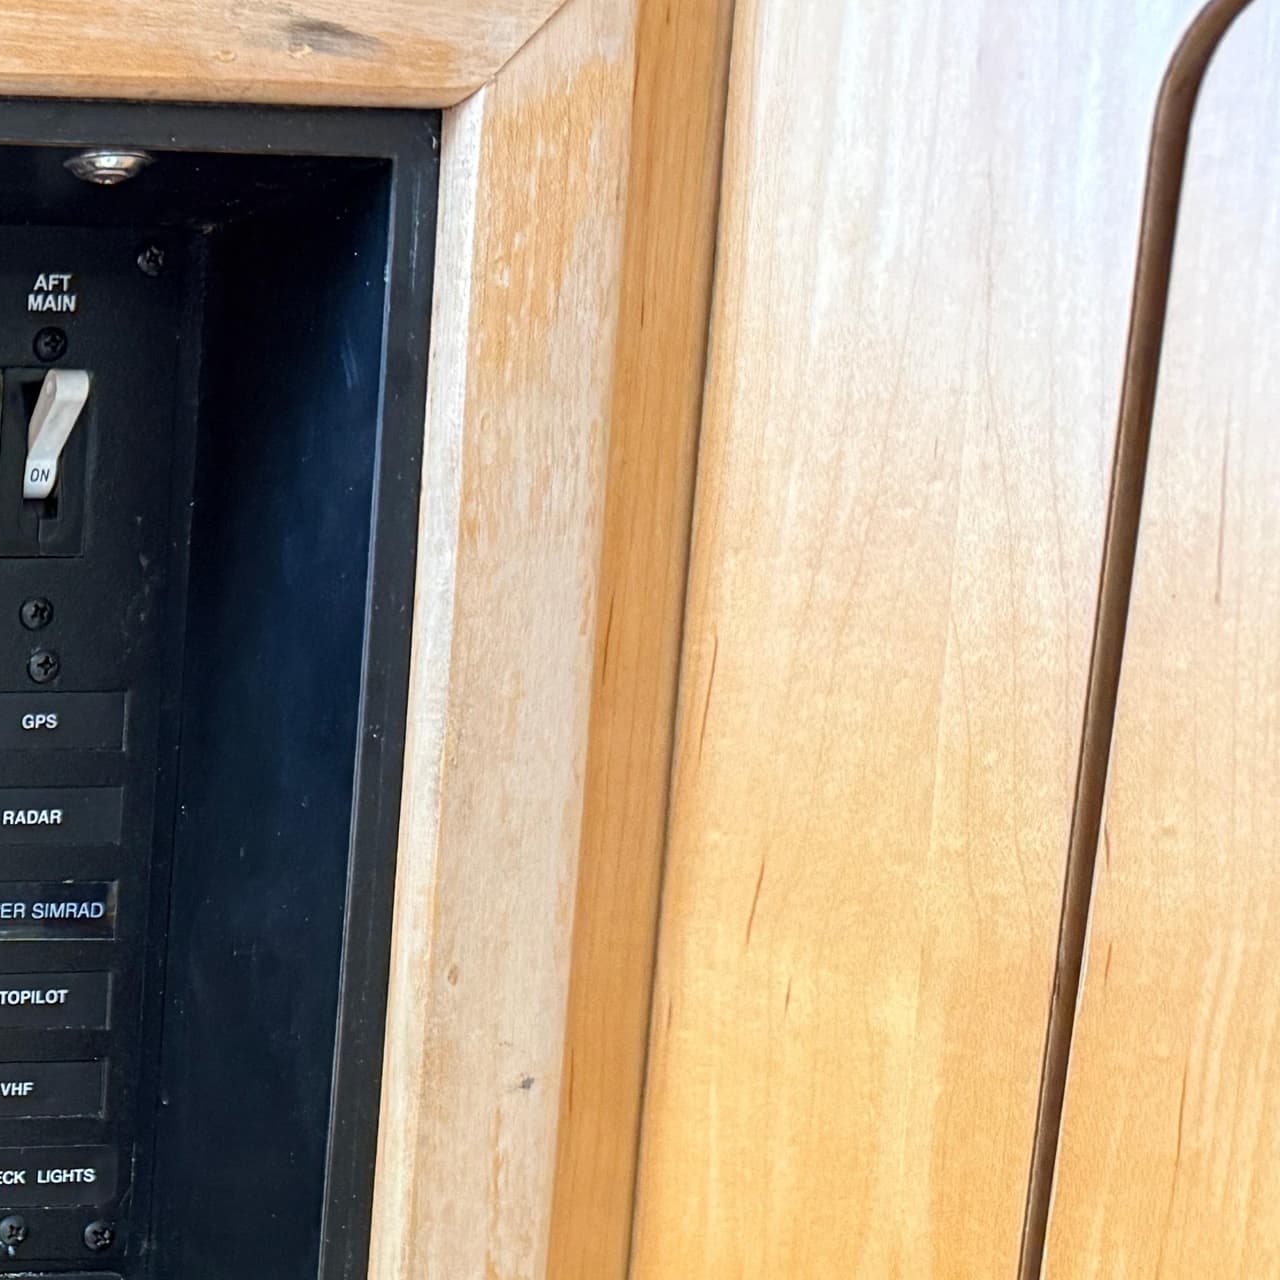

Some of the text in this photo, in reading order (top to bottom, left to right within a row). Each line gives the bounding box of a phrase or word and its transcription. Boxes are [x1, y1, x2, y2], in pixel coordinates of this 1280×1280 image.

[33, 274, 72, 291] AFT
[28, 295, 76, 312] MAIN
[30, 468, 50, 483] ON
[21, 714, 58, 729] GPS
[2, 810, 62, 825] RADAR
[31, 902, 104, 919] SIMRAD
[0, 1082, 34, 1096] VHF
[37, 1168, 97, 1184] LIGHTS
